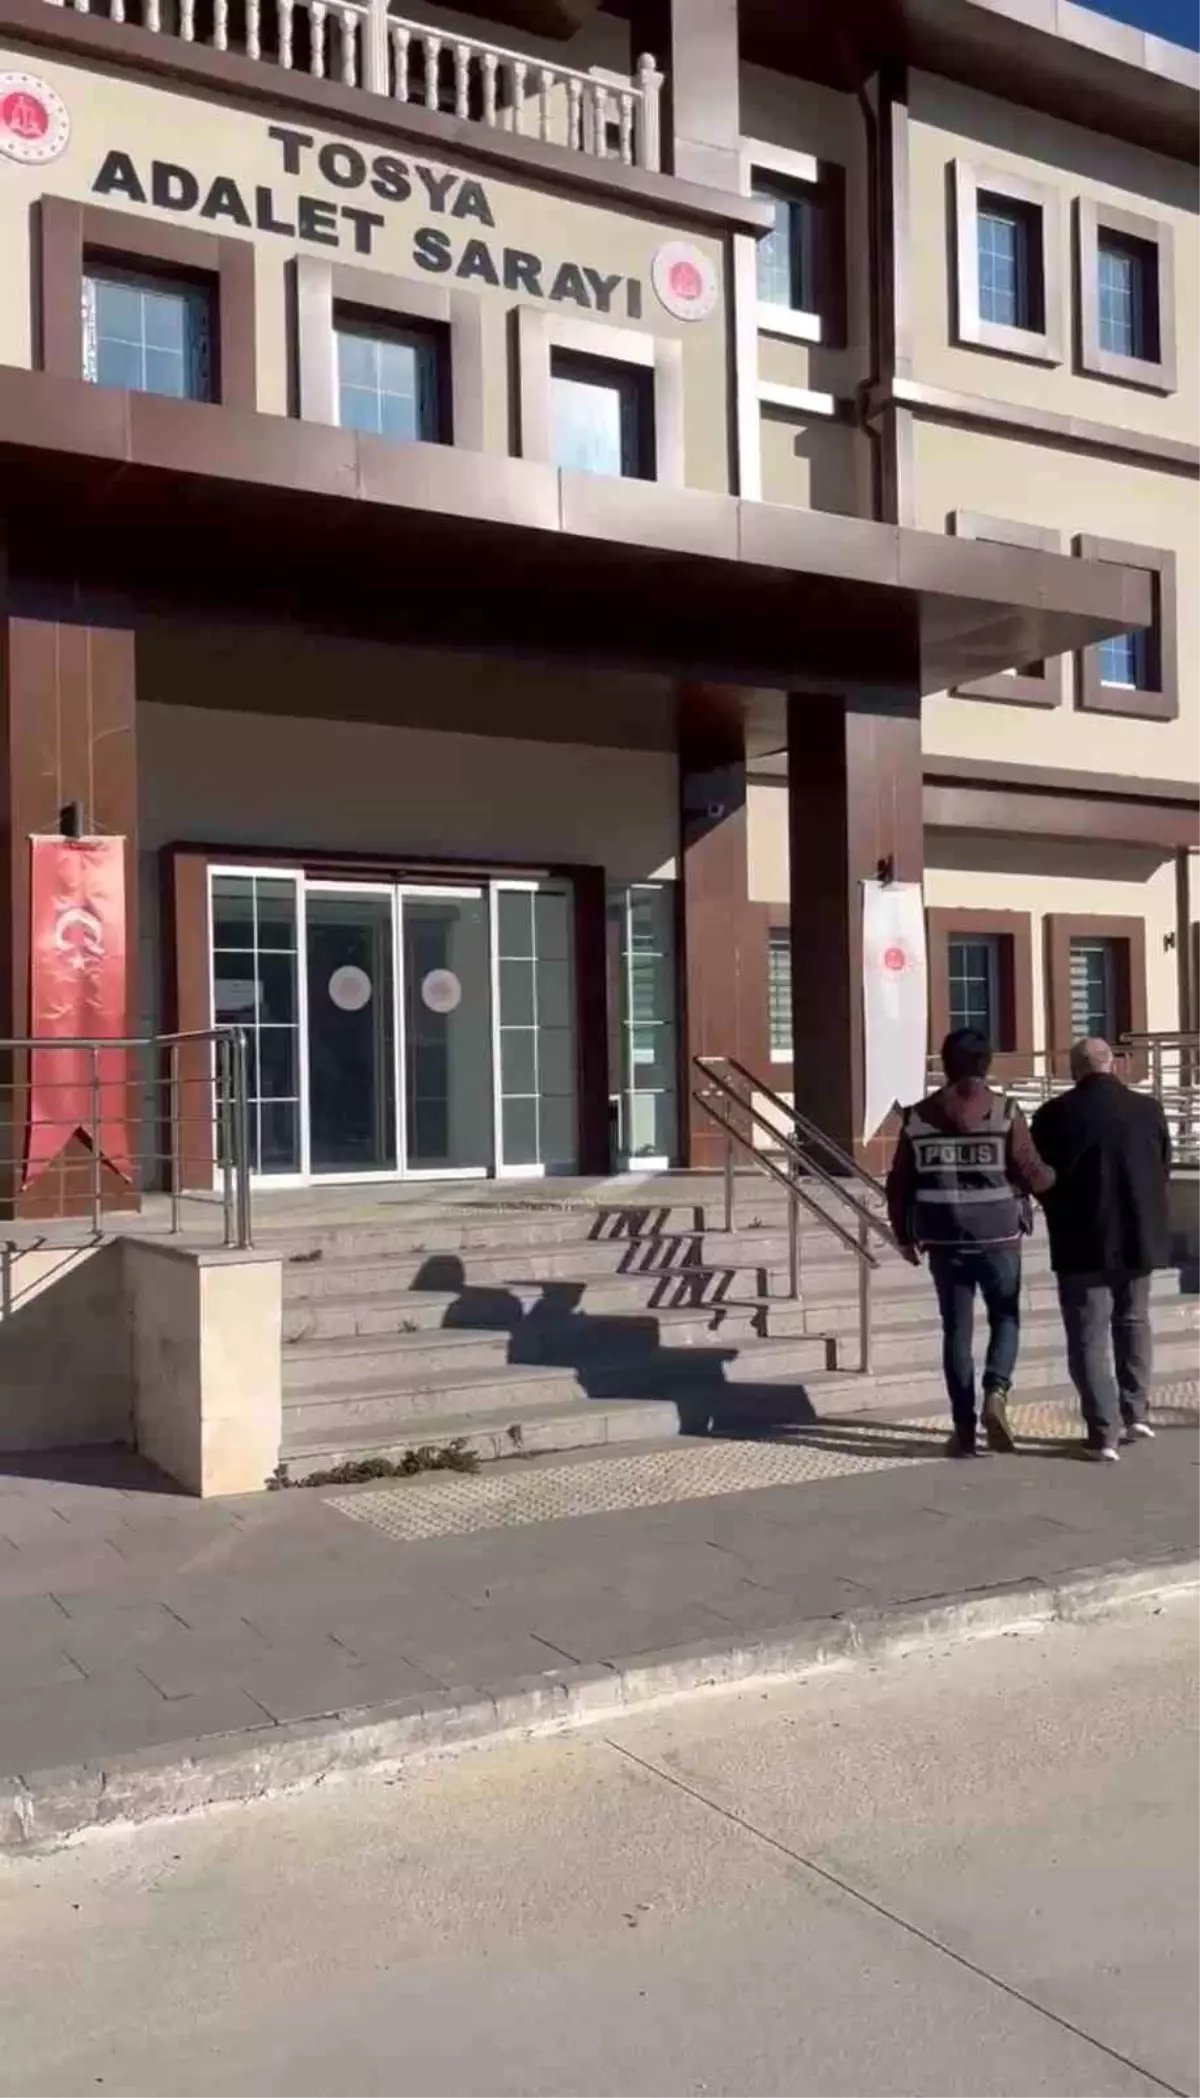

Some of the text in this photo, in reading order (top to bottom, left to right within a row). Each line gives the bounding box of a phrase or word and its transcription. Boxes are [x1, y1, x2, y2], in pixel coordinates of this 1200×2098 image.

[92, 150, 642, 319] ADALET SARAYI
[268, 126, 495, 227] TOSYA
